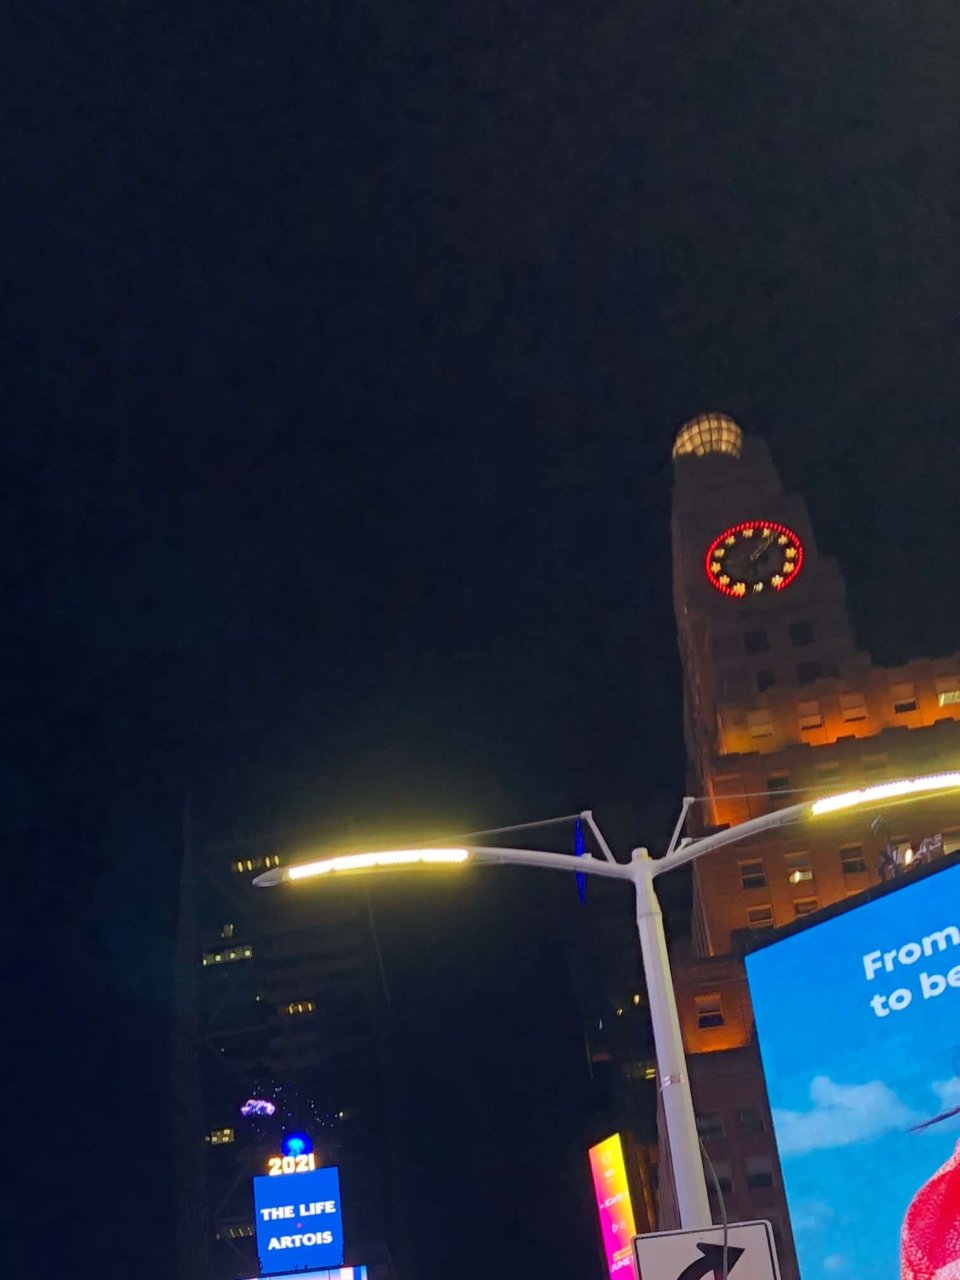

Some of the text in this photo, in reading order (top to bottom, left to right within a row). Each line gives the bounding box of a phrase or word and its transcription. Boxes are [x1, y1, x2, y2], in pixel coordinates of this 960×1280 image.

[862, 925, 960, 981] From
[870, 988, 912, 1017] to
[268, 1153, 316, 1176] 2021
[260, 1200, 336, 1222] THE LIFE
[268, 1231, 333, 1251] ARTOIS
